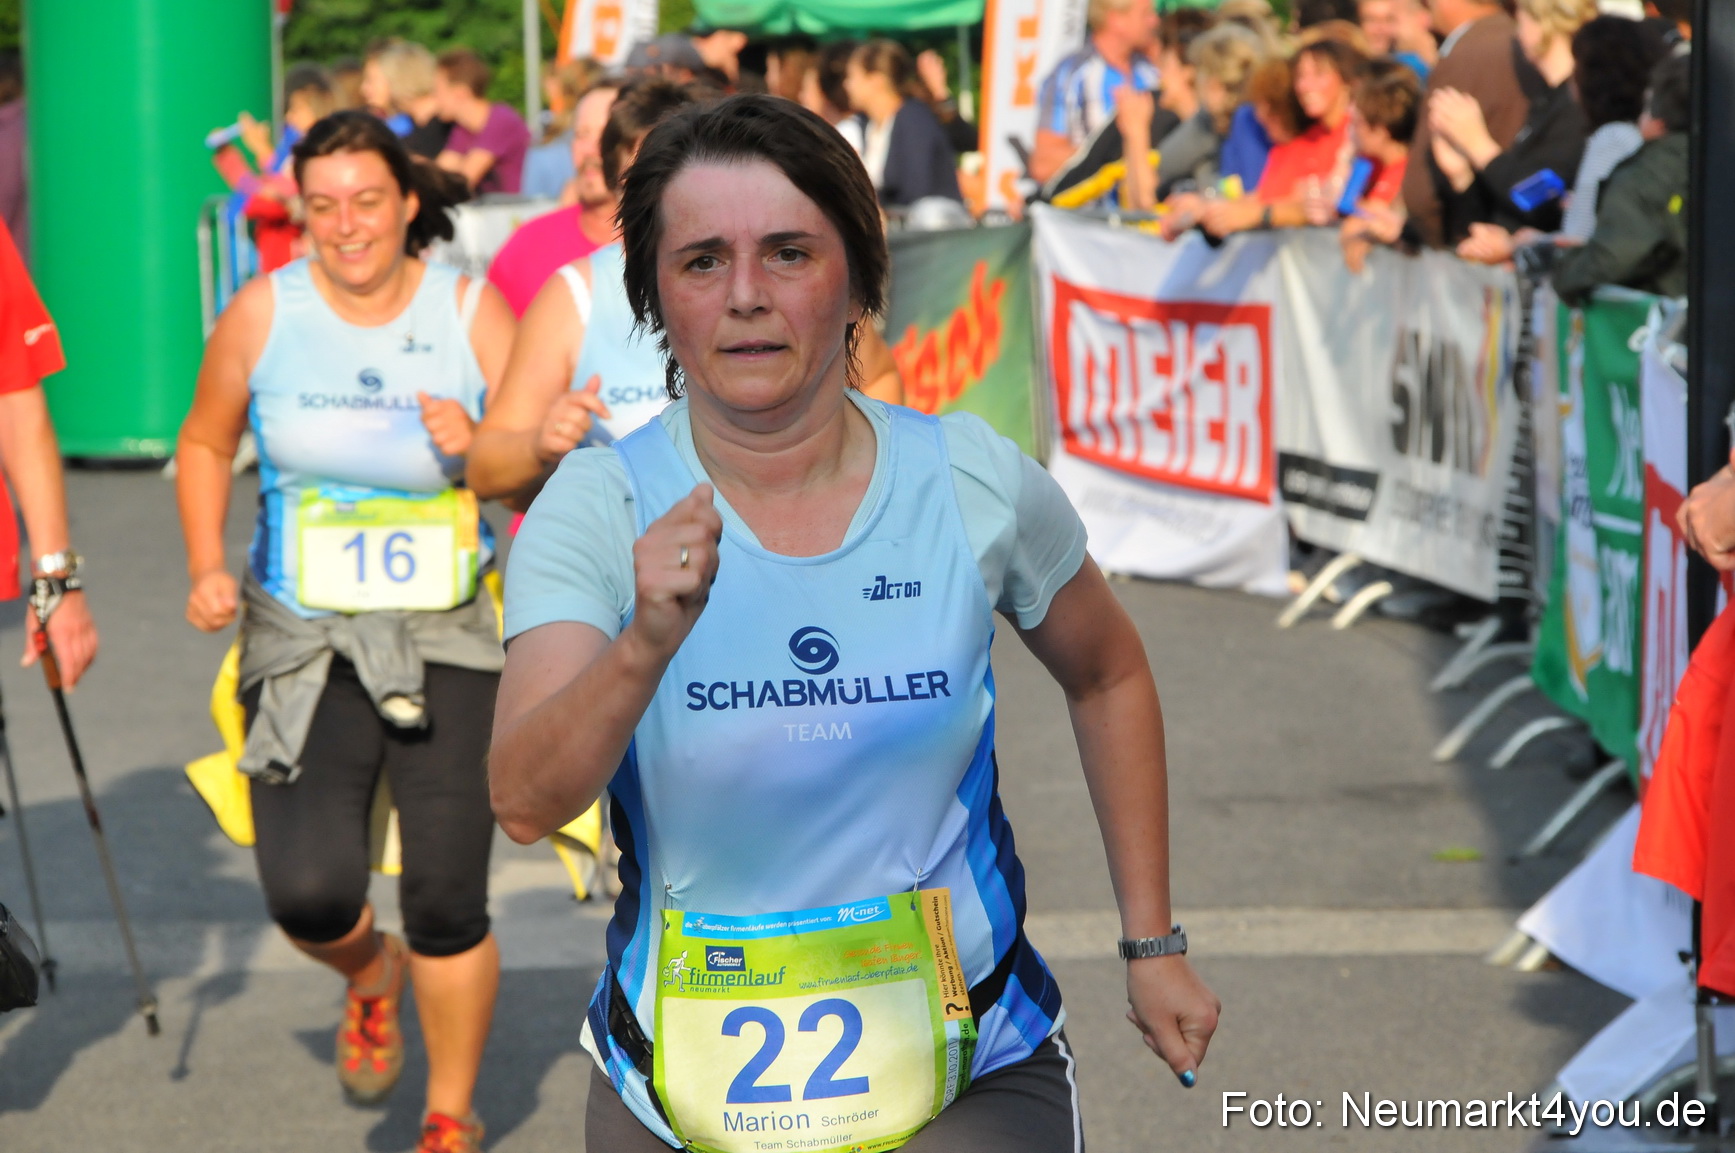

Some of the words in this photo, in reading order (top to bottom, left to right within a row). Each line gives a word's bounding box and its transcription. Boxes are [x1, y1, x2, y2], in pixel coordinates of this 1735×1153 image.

[1068, 299, 1261, 489] MEIER
[344, 531, 416, 583] 16
[686, 670, 951, 711] SCHABMÜLLER
[783, 722, 852, 742] TEAM
[837, 905, 885, 922] M-net
[932, 896, 942, 931] Gutschein
[940, 936, 949, 960] Aktion
[689, 966, 787, 986] firmenlauf
[938, 958, 947, 982] könnte
[946, 965, 958, 997] Werbung
[942, 983, 950, 998] Hier
[945, 1002, 969, 1015] ?
[721, 998, 869, 1103] 22
[723, 1110, 810, 1132] Marion
[821, 1108, 879, 1127] Schröder
[754, 1140, 783, 1150] Team
[786, 1133, 853, 1149] Schabmüller
